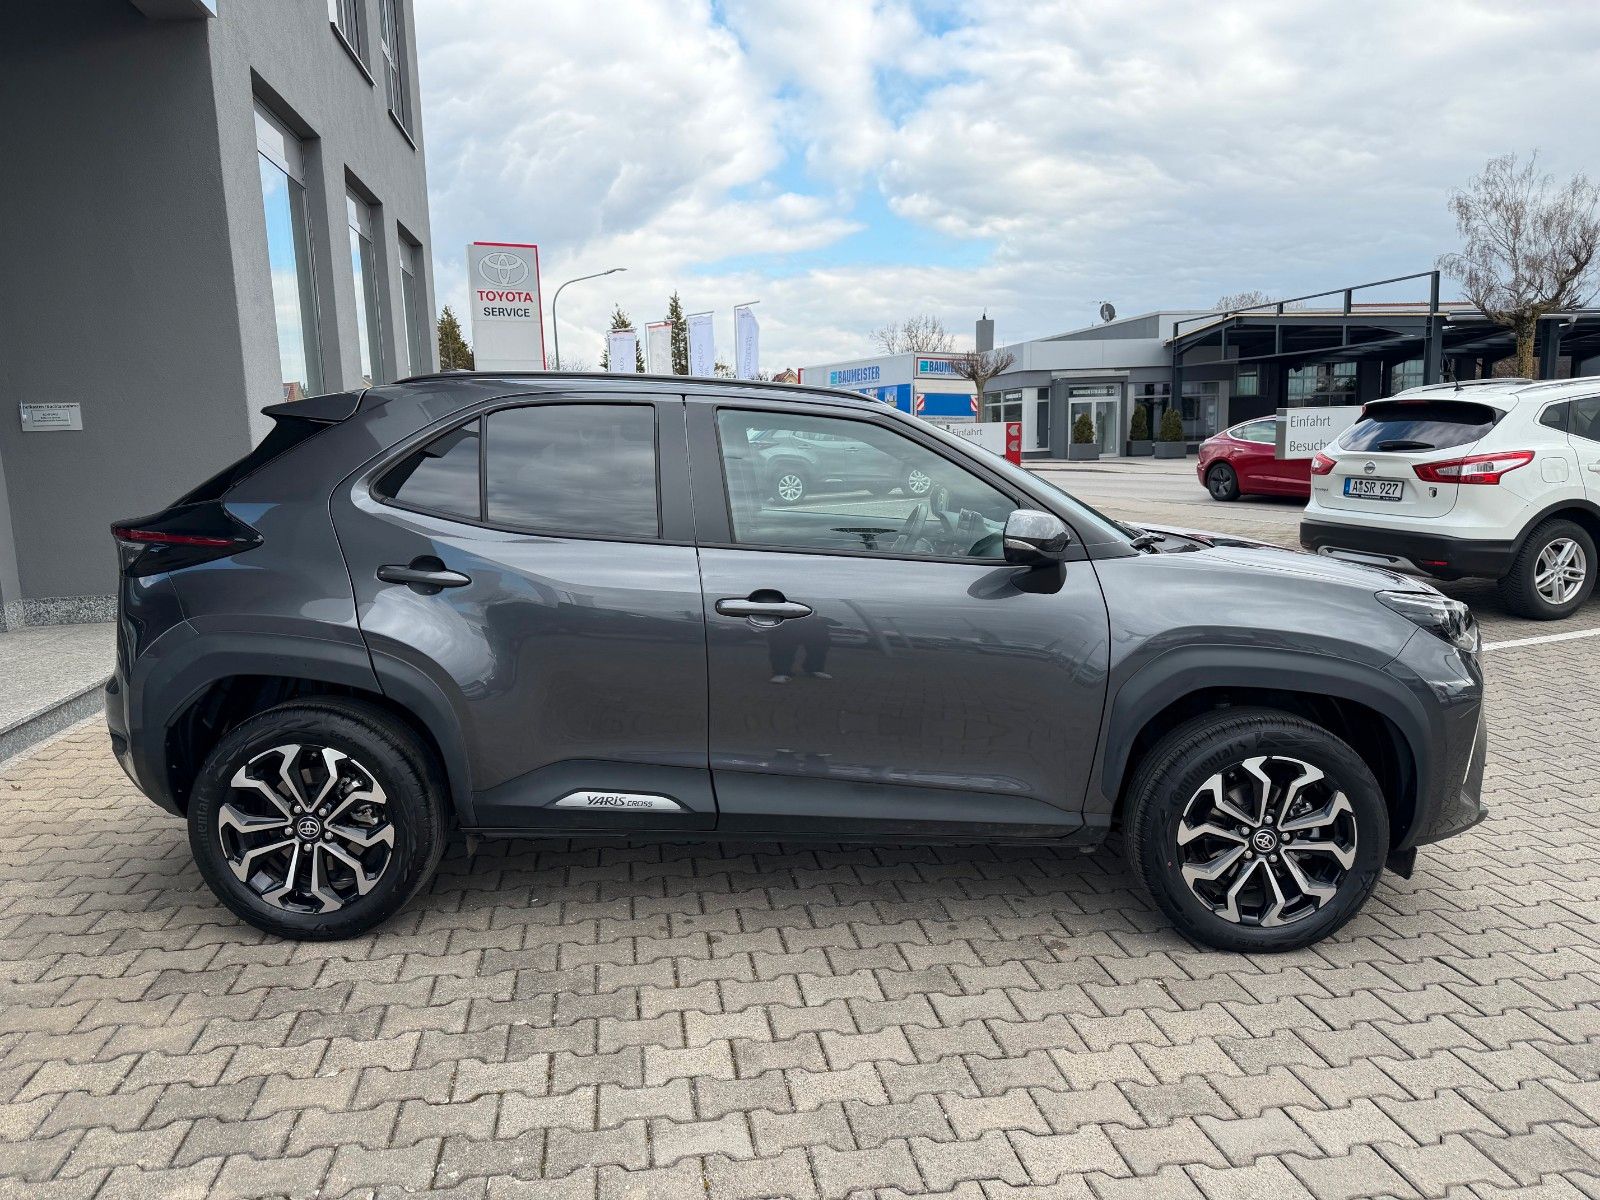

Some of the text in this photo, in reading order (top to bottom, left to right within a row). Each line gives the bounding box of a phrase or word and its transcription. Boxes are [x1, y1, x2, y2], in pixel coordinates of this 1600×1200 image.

[477, 290, 533, 302] TOYOTA
[483, 306, 530, 318] SERVICE
[838, 366, 880, 384] BAUMEISTER
[1290, 415, 1331, 428] Einfahrt
[952, 428, 983, 437] Einfahrt
[1380, 483, 1399, 496] 927
[627, 800, 653, 808] CROSS
